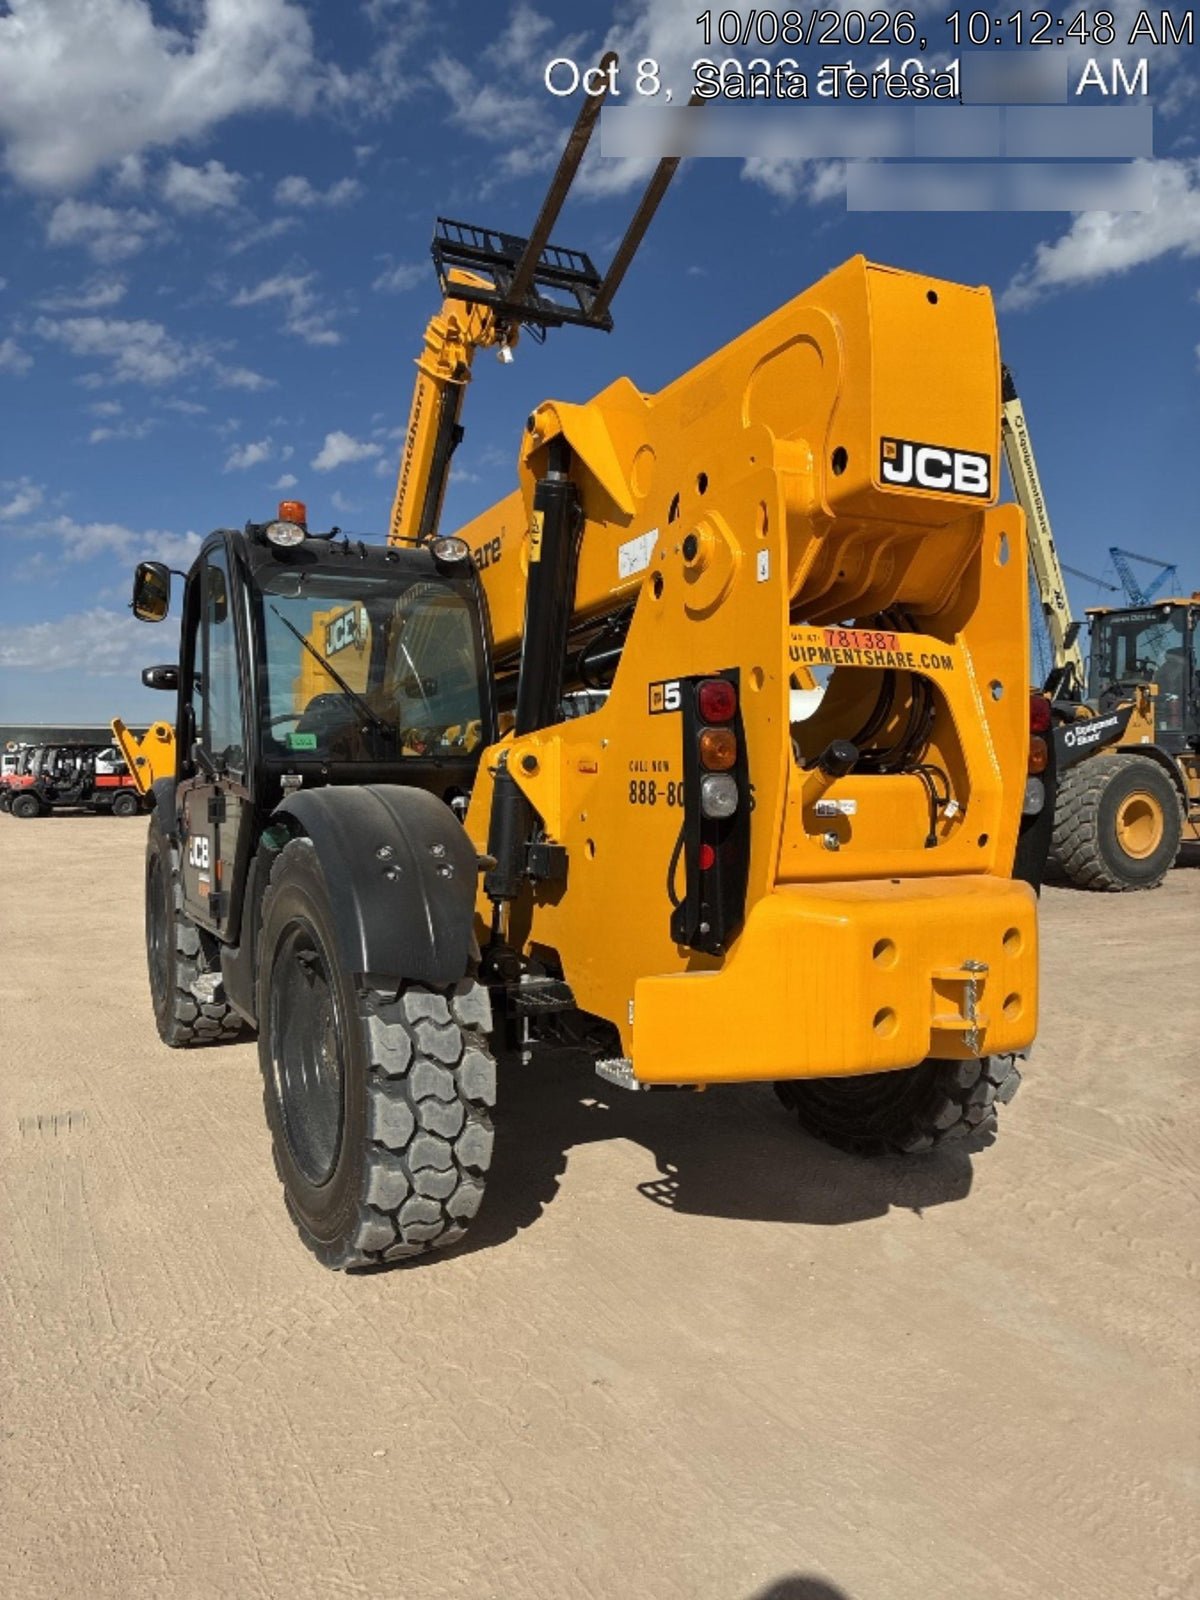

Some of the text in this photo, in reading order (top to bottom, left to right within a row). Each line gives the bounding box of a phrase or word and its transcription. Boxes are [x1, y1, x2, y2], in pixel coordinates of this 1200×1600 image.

[882, 444, 989, 494] JCB
[826, 629, 896, 650] 781387
[788, 645, 954, 671] UIPMENTSHARE.COM
[189, 836, 209, 869] JCB
